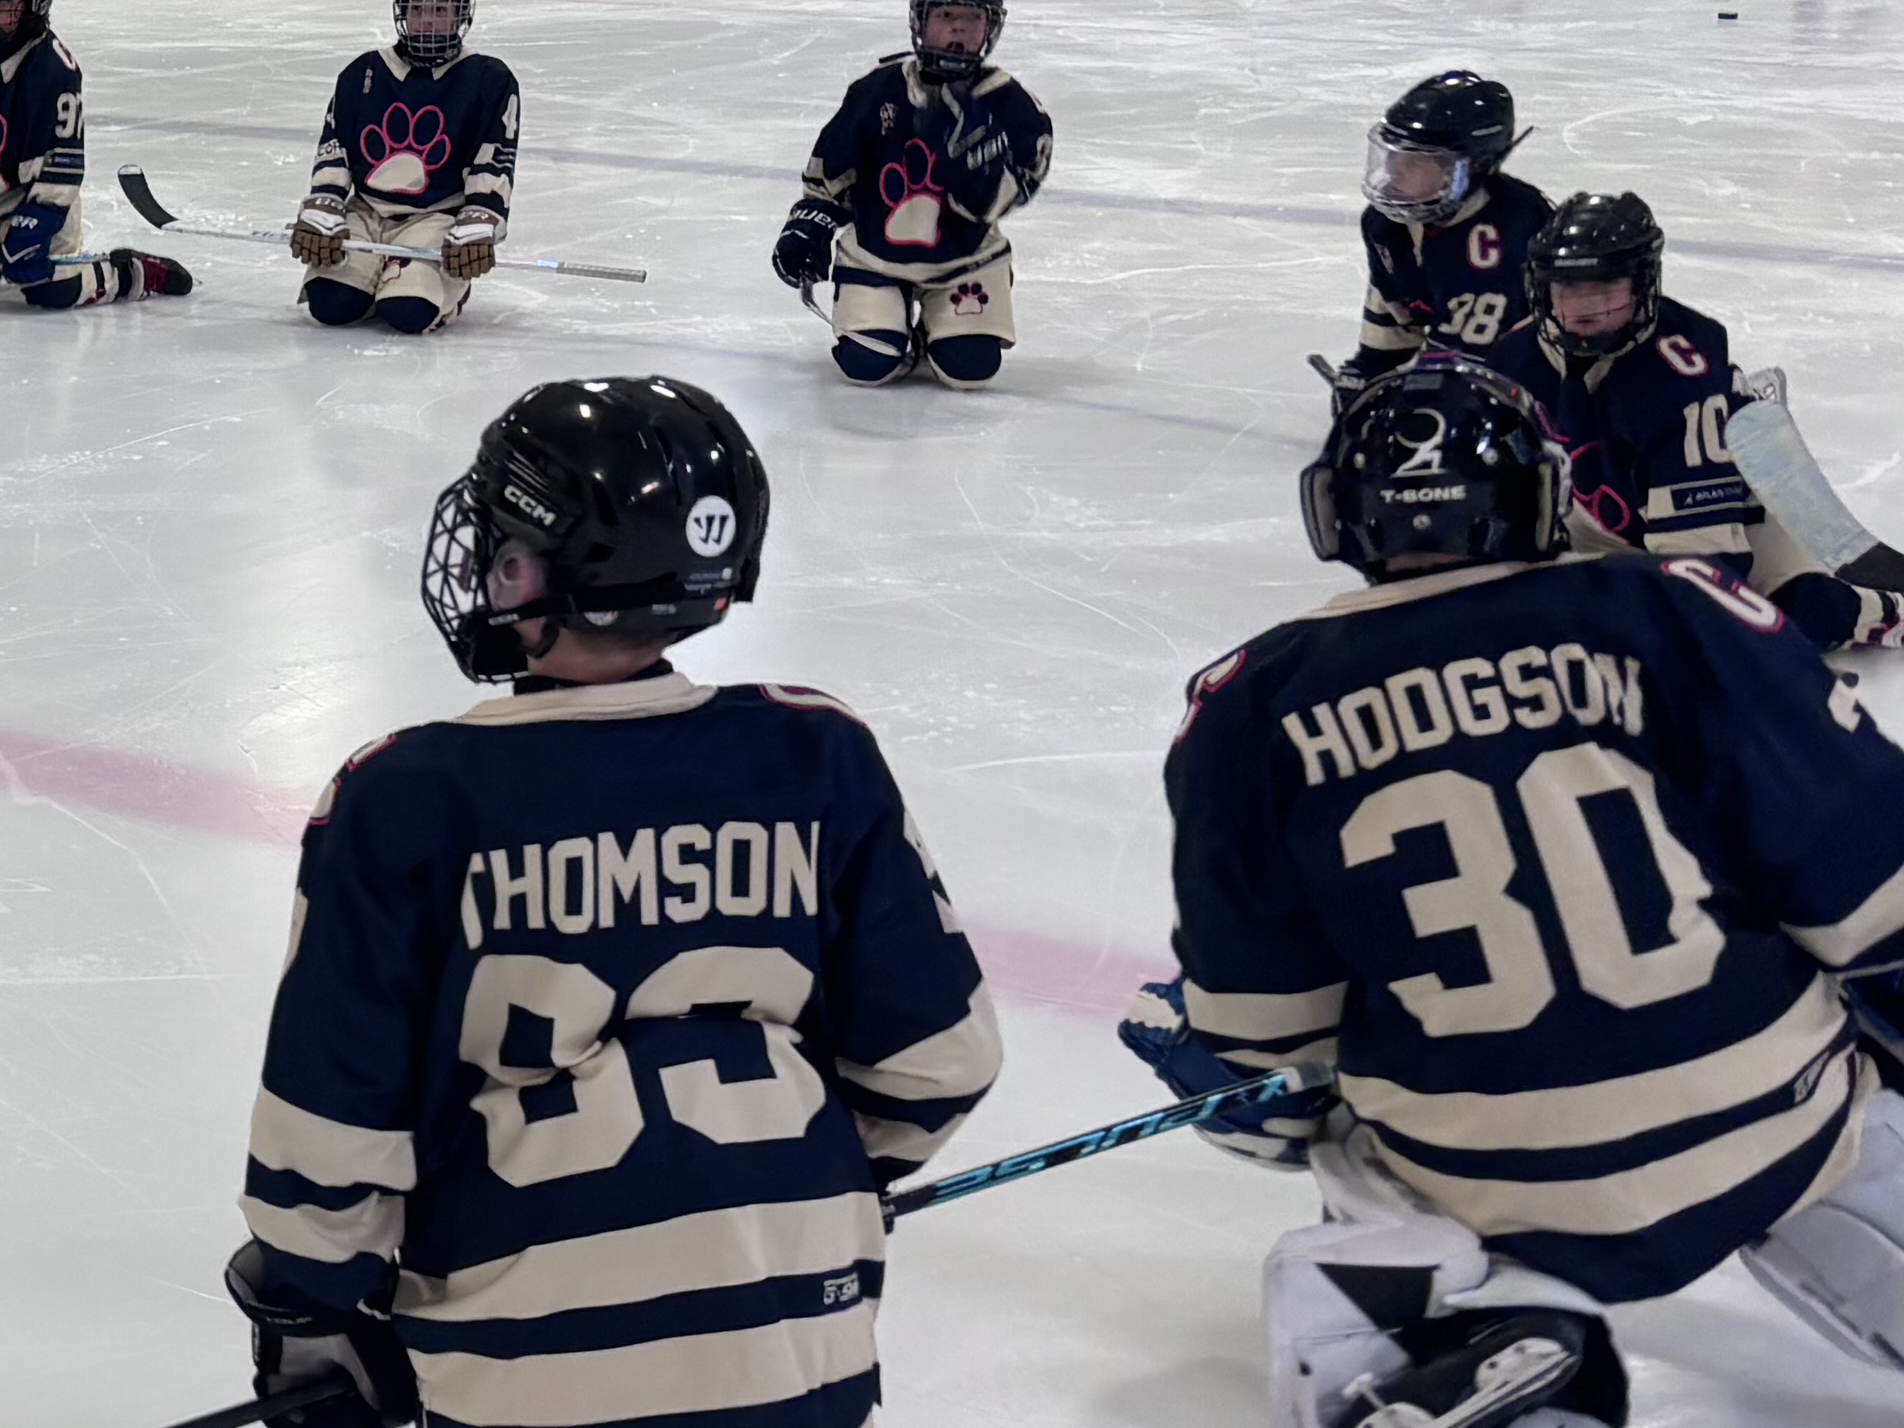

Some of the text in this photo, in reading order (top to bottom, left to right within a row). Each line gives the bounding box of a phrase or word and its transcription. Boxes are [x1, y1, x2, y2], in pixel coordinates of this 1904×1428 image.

[1467, 223, 1501, 271] C
[1438, 292, 1507, 345] 38
[1656, 334, 1708, 377] C
[503, 483, 558, 527] CCM
[1380, 484, 1467, 504] T-BONE
[1282, 643, 1644, 787] HODGSON
[458, 820, 823, 950] THOMSON
[1338, 742, 1728, 1038] 30
